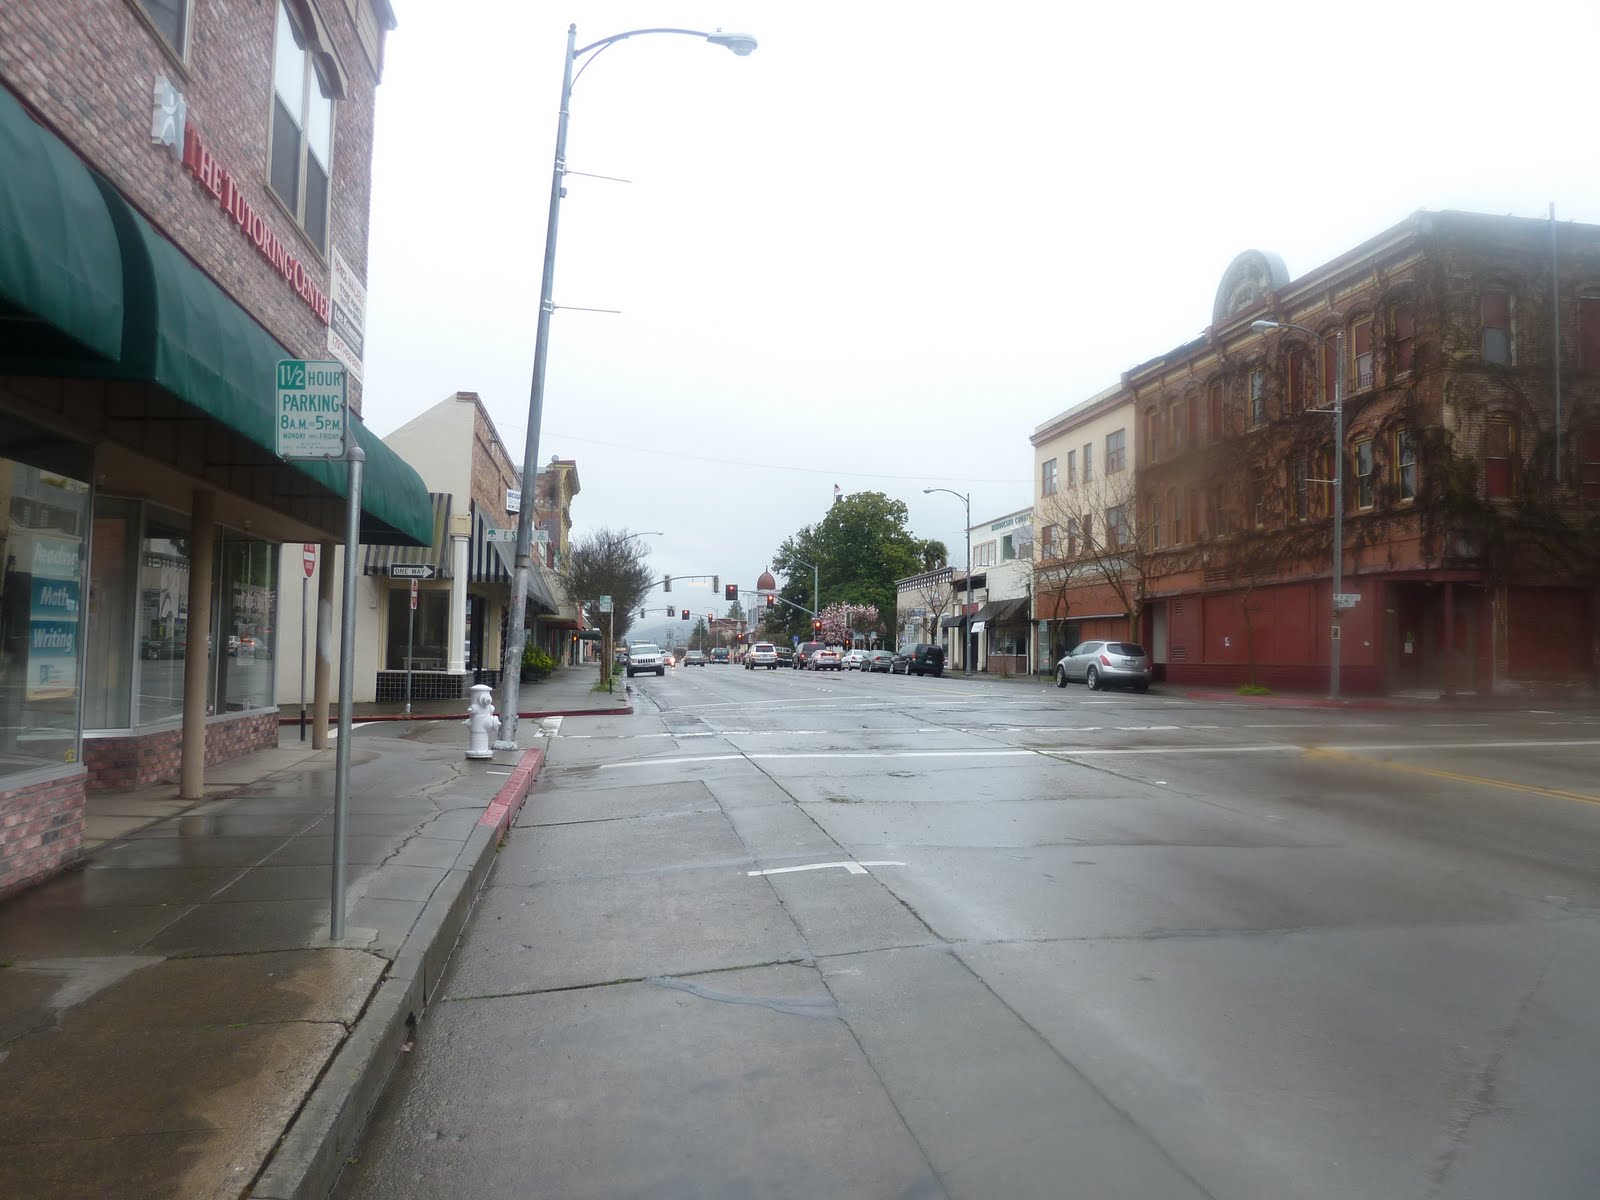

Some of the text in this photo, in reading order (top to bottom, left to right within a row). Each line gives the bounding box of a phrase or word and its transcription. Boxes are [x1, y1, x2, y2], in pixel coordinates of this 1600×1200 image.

[185, 121, 331, 323] THE TUTORING CENTER
[308, 371, 340, 387] HOUR
[283, 394, 339, 412] PARKING
[504, 531, 508, 540] E
[34, 541, 78, 572] Reading
[394, 567, 409, 575] ONE
[40, 586, 69, 606] Math
[33, 627, 73, 652] Writing
